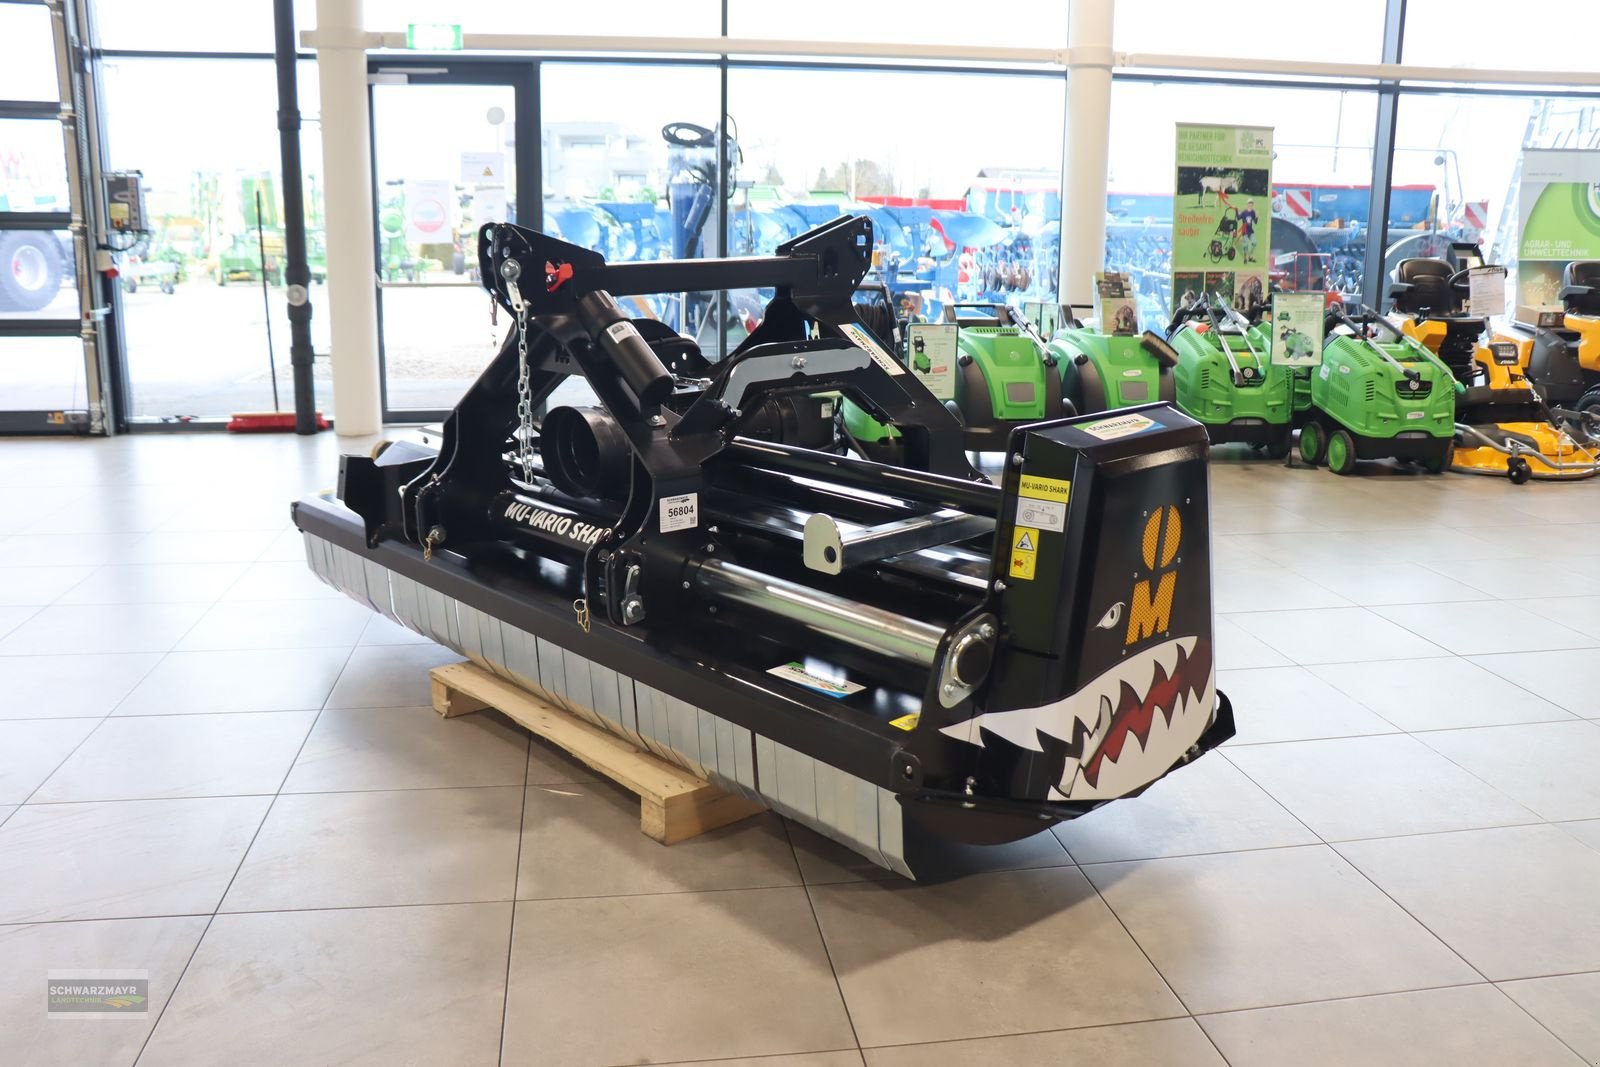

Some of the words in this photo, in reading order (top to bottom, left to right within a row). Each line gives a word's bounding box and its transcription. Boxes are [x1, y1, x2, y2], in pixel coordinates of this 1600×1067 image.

[1524, 240, 1553, 248] AGRAR-
[1555, 240, 1572, 249] UND
[1524, 248, 1589, 257] UMWELTTECHNIK
[1021, 481, 1048, 492] MU-VARIO
[1049, 485, 1068, 495] SHARK
[668, 504, 694, 518] 56804
[504, 501, 572, 536] MU-VARIO
